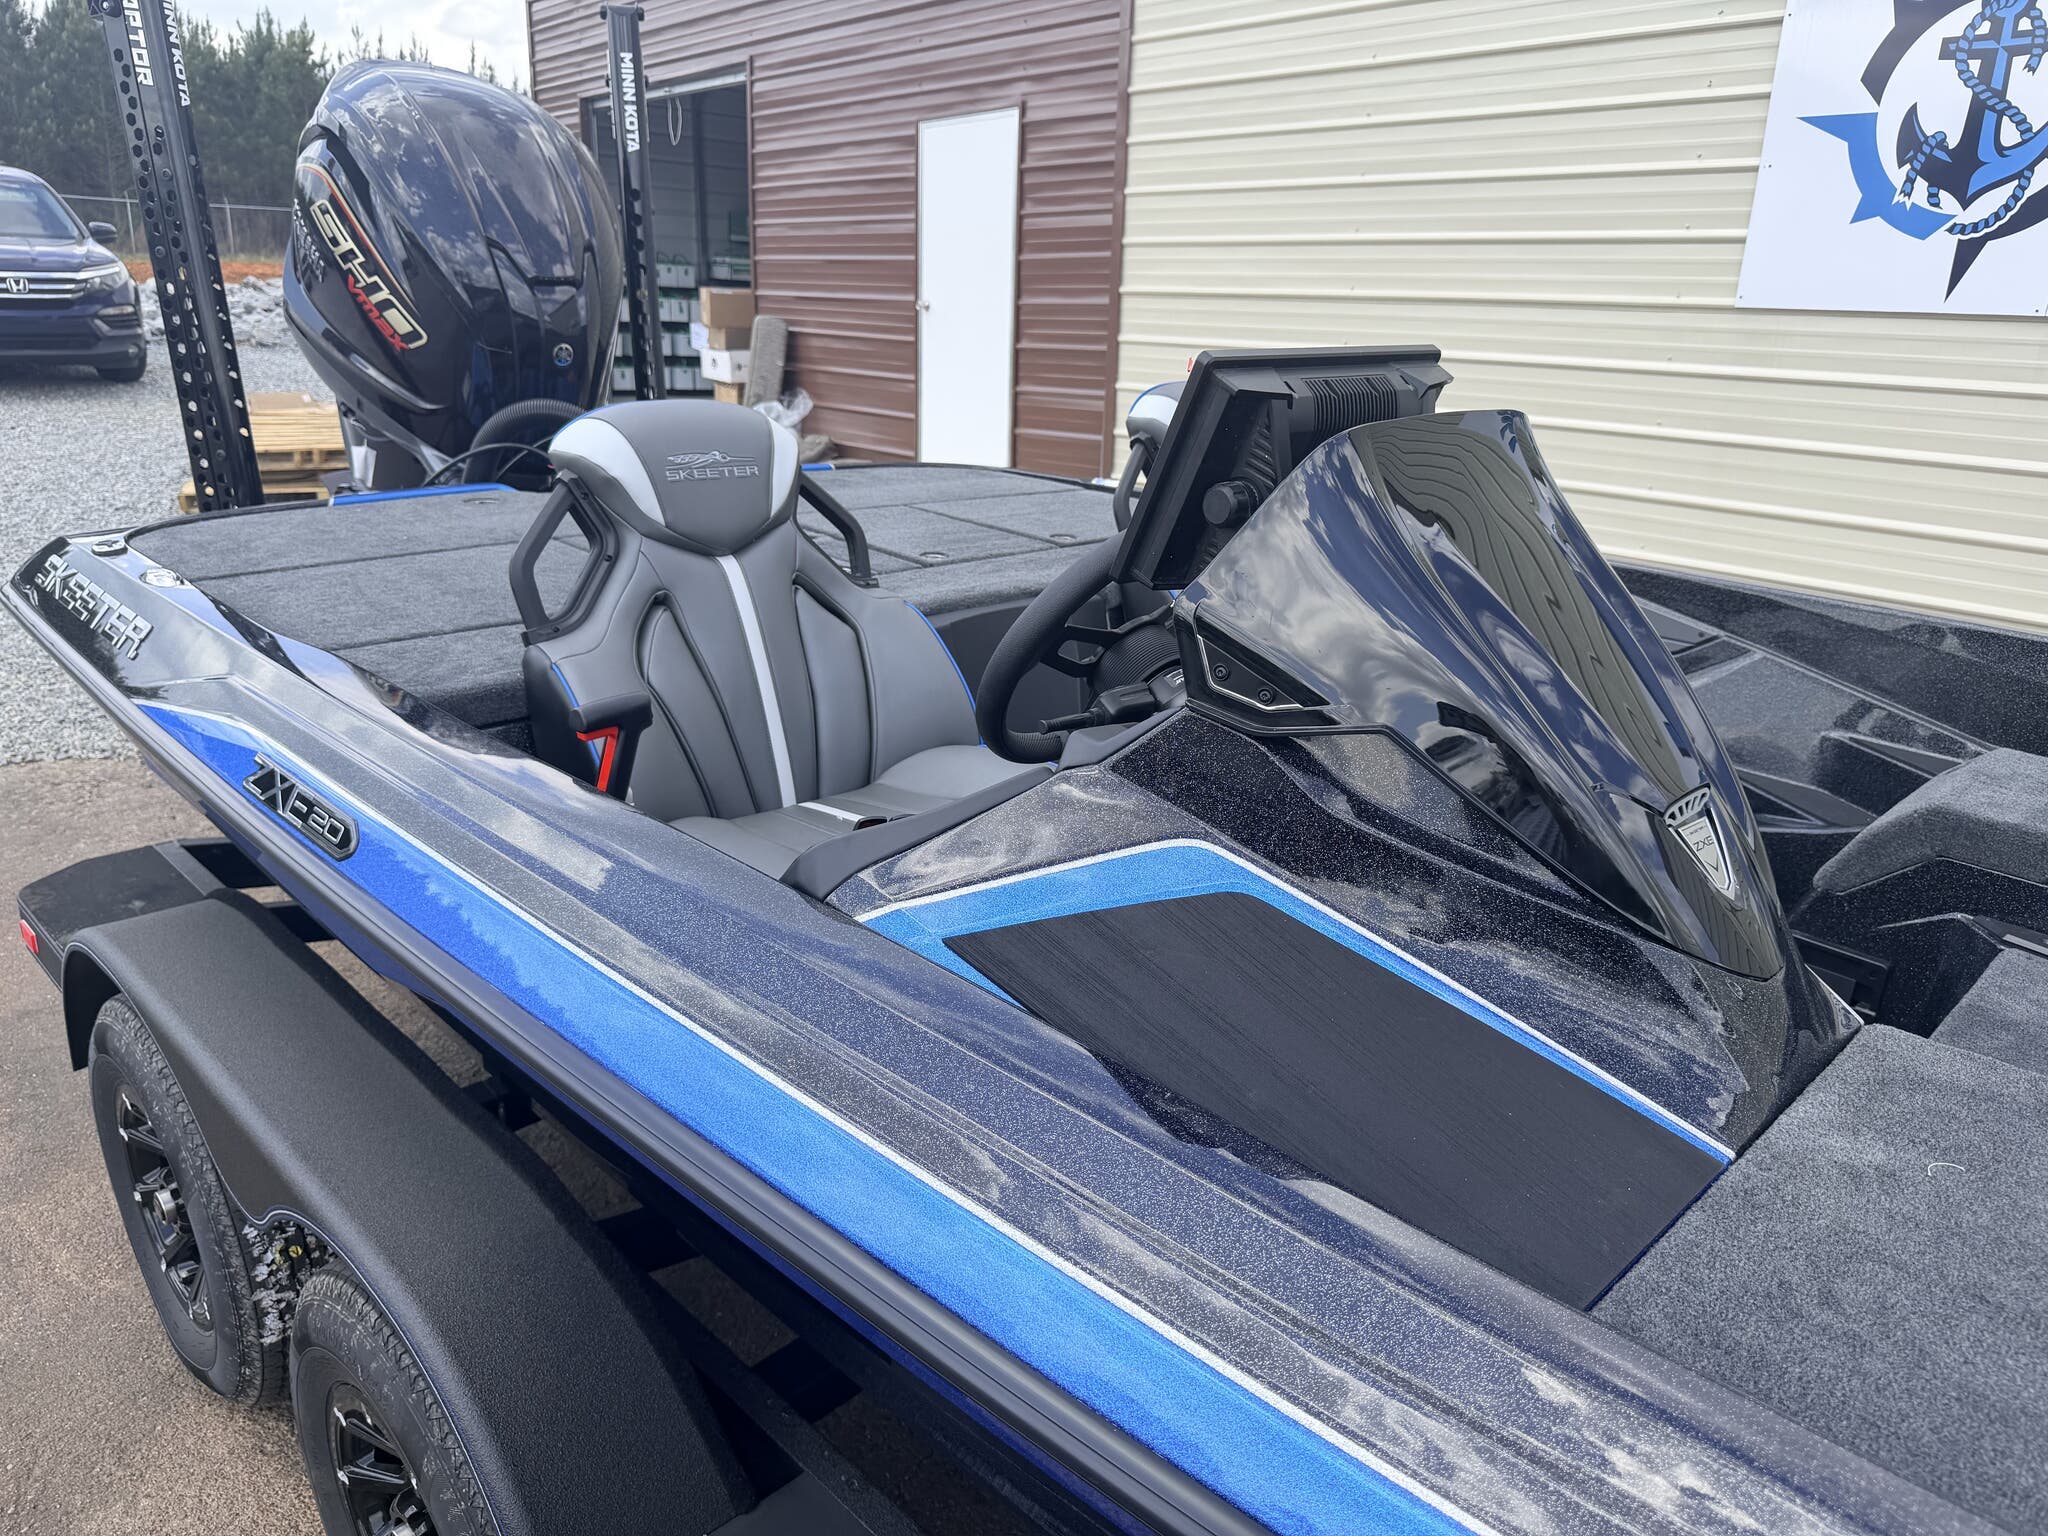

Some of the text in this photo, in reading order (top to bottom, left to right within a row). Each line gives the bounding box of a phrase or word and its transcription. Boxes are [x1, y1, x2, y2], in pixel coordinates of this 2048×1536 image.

[162, 0, 191, 107] INN KOTA
[620, 51, 641, 153] MINN KOTA
[310, 199, 428, 349] SHO
[665, 465, 760, 481] SKEETER
[34, 554, 154, 660] SKEETER
[1692, 835, 1715, 852] ZXE
